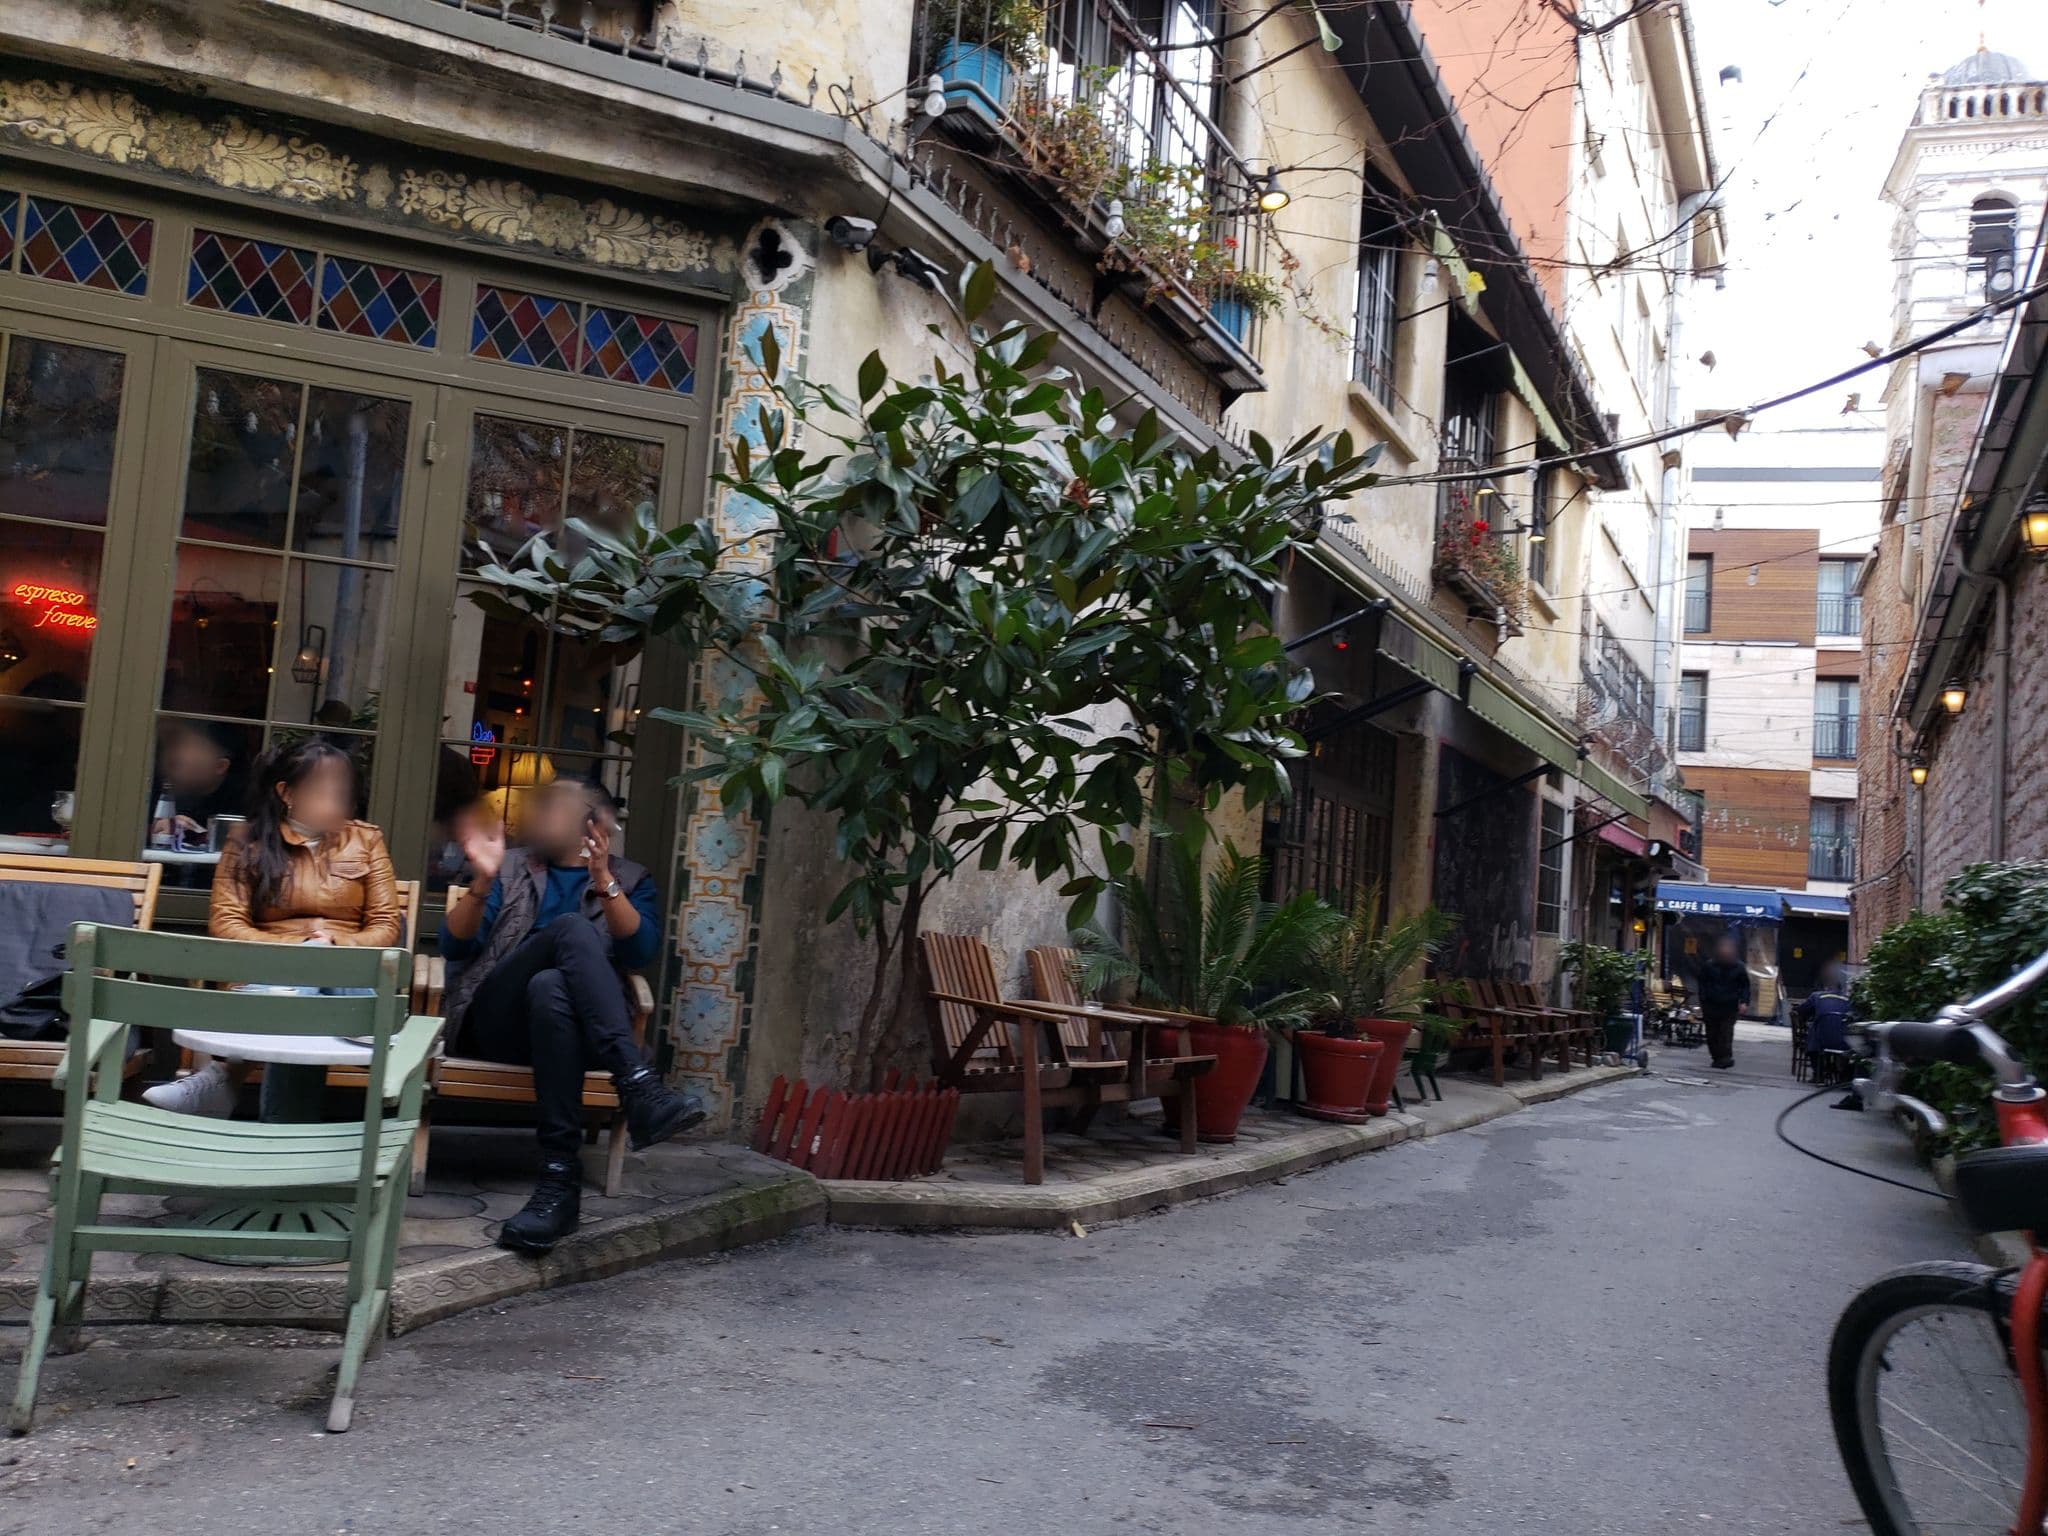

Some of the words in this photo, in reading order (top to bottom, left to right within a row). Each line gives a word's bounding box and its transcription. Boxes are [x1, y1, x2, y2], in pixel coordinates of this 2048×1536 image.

[15, 584, 84, 605] espresso
[34, 605, 97, 629] foreve
[1702, 903, 1721, 912] BAR
